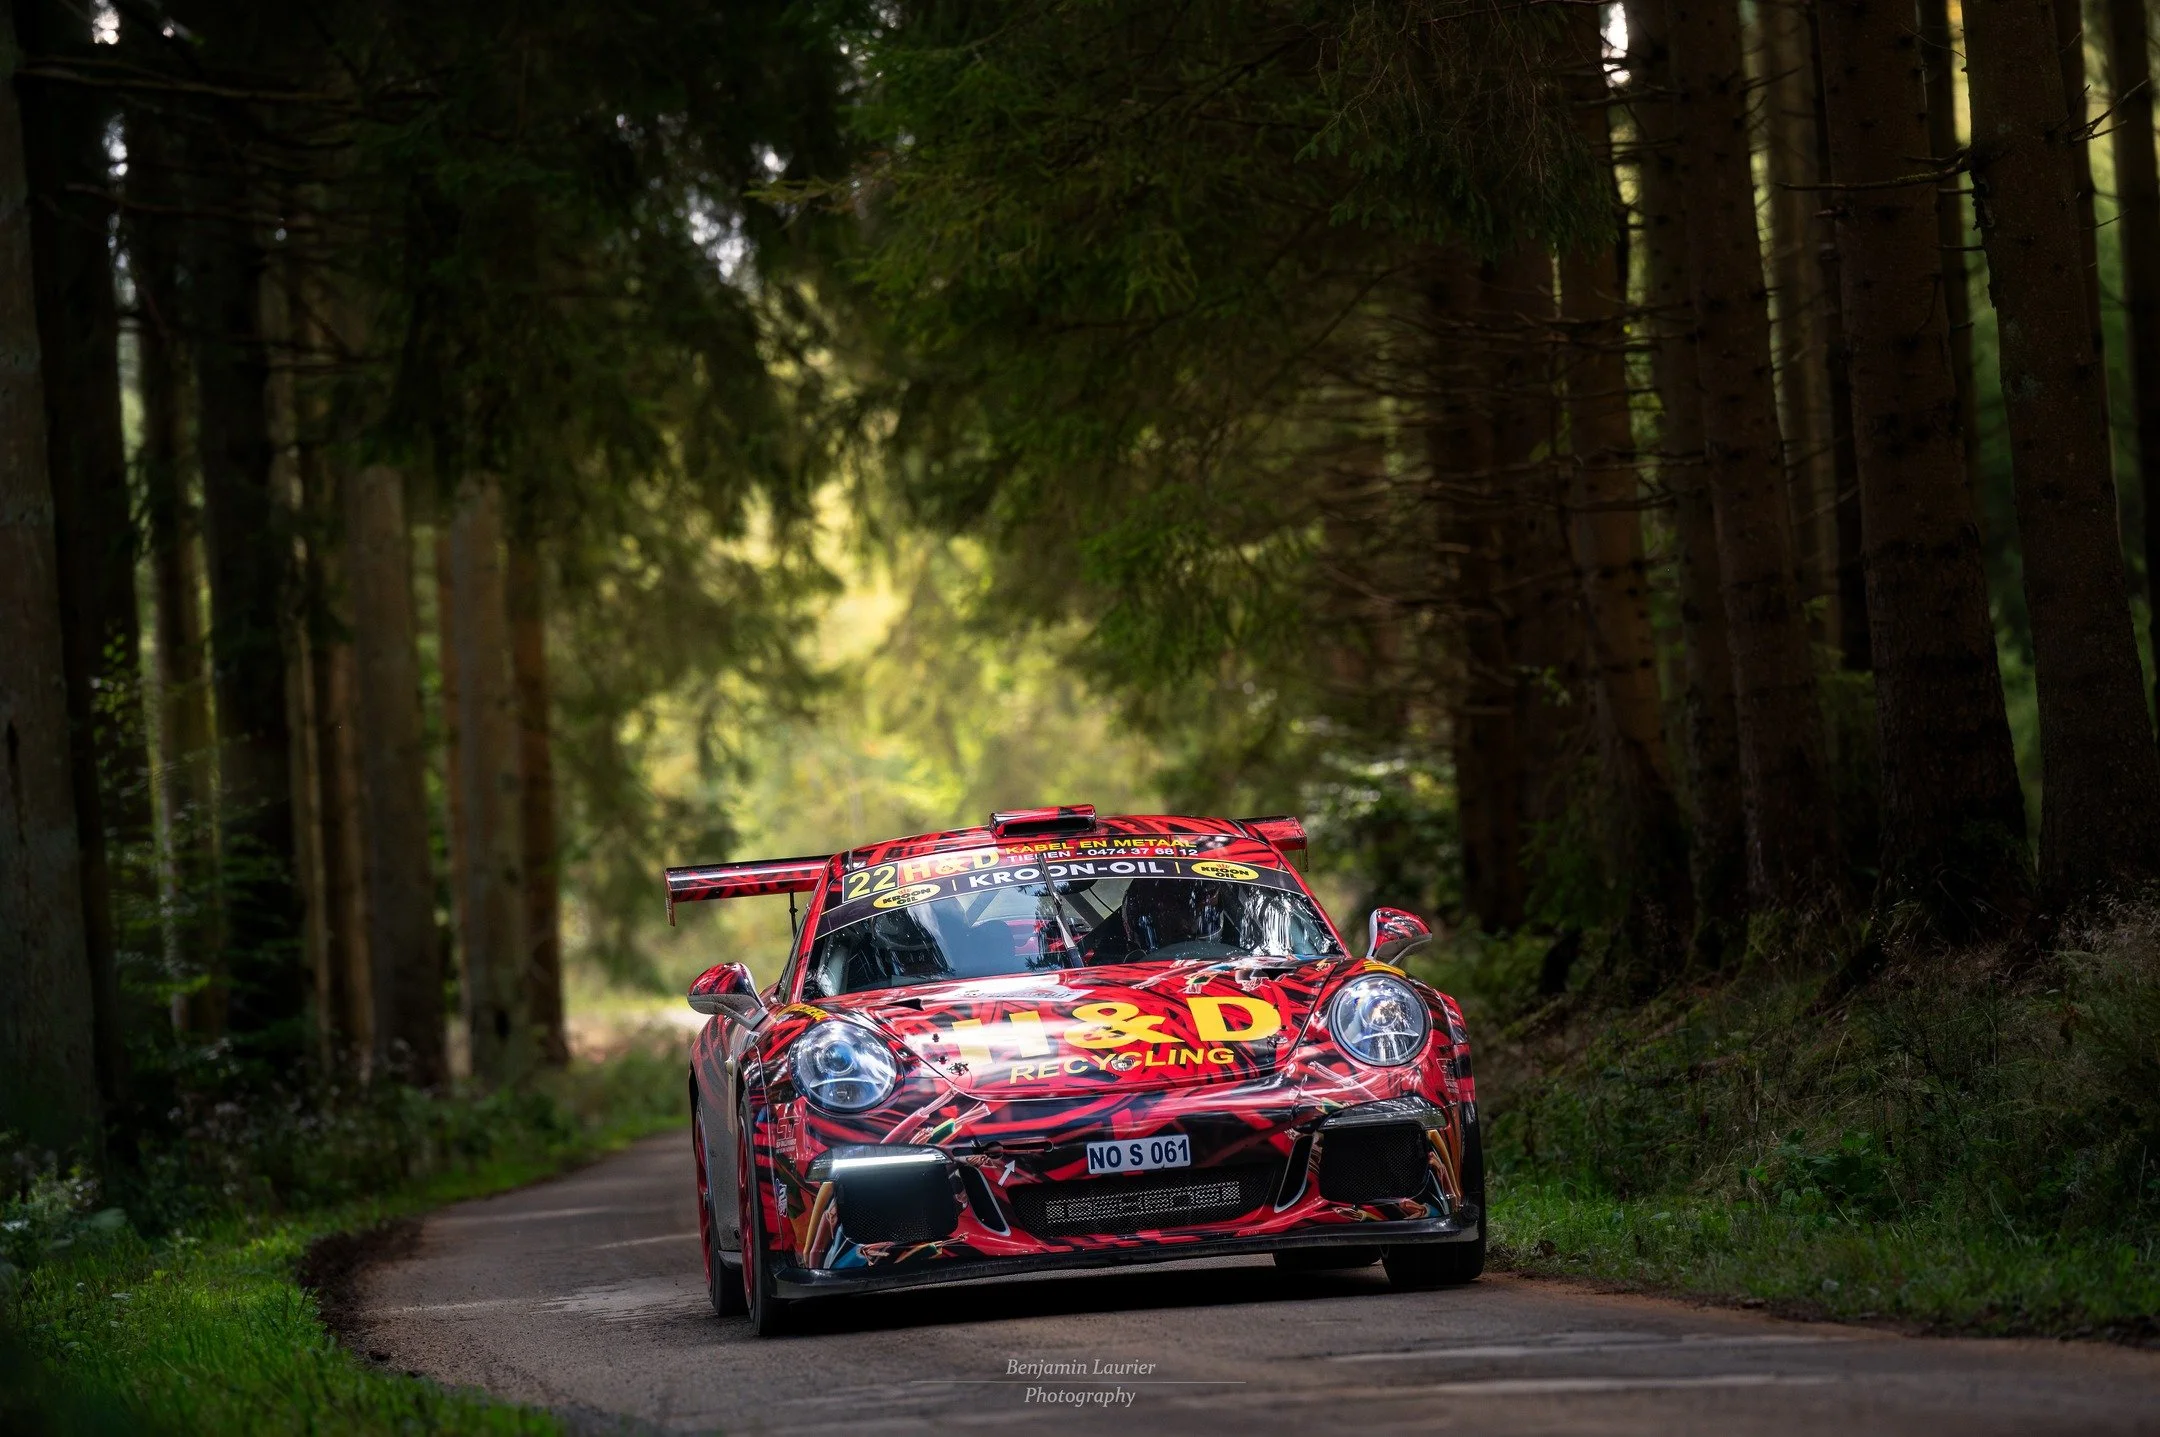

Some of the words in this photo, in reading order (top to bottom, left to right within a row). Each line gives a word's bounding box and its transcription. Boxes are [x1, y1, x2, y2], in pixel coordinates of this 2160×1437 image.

[1005, 840, 1074, 855] KABEL
[1080, 839, 1111, 849] EN
[1114, 838, 1197, 848] METAAL
[1087, 848, 1127, 856] 0474
[1130, 847, 1150, 855] 37
[1154, 847, 1174, 855] 68
[1178, 848, 1198, 856] 12
[902, 850, 1000, 882] H&D
[969, 861, 1165, 888] KROON-OIL
[1200, 866, 1250, 876] KROON
[847, 865, 896, 900] 22
[882, 887, 931, 904] KROON
[896, 896, 918, 905] OIL
[1009, 1047, 1235, 1084] RECYCLING
[1089, 1145, 1122, 1170] NO
[1129, 1143, 1144, 1166] S
[1151, 1139, 1189, 1164] 061
